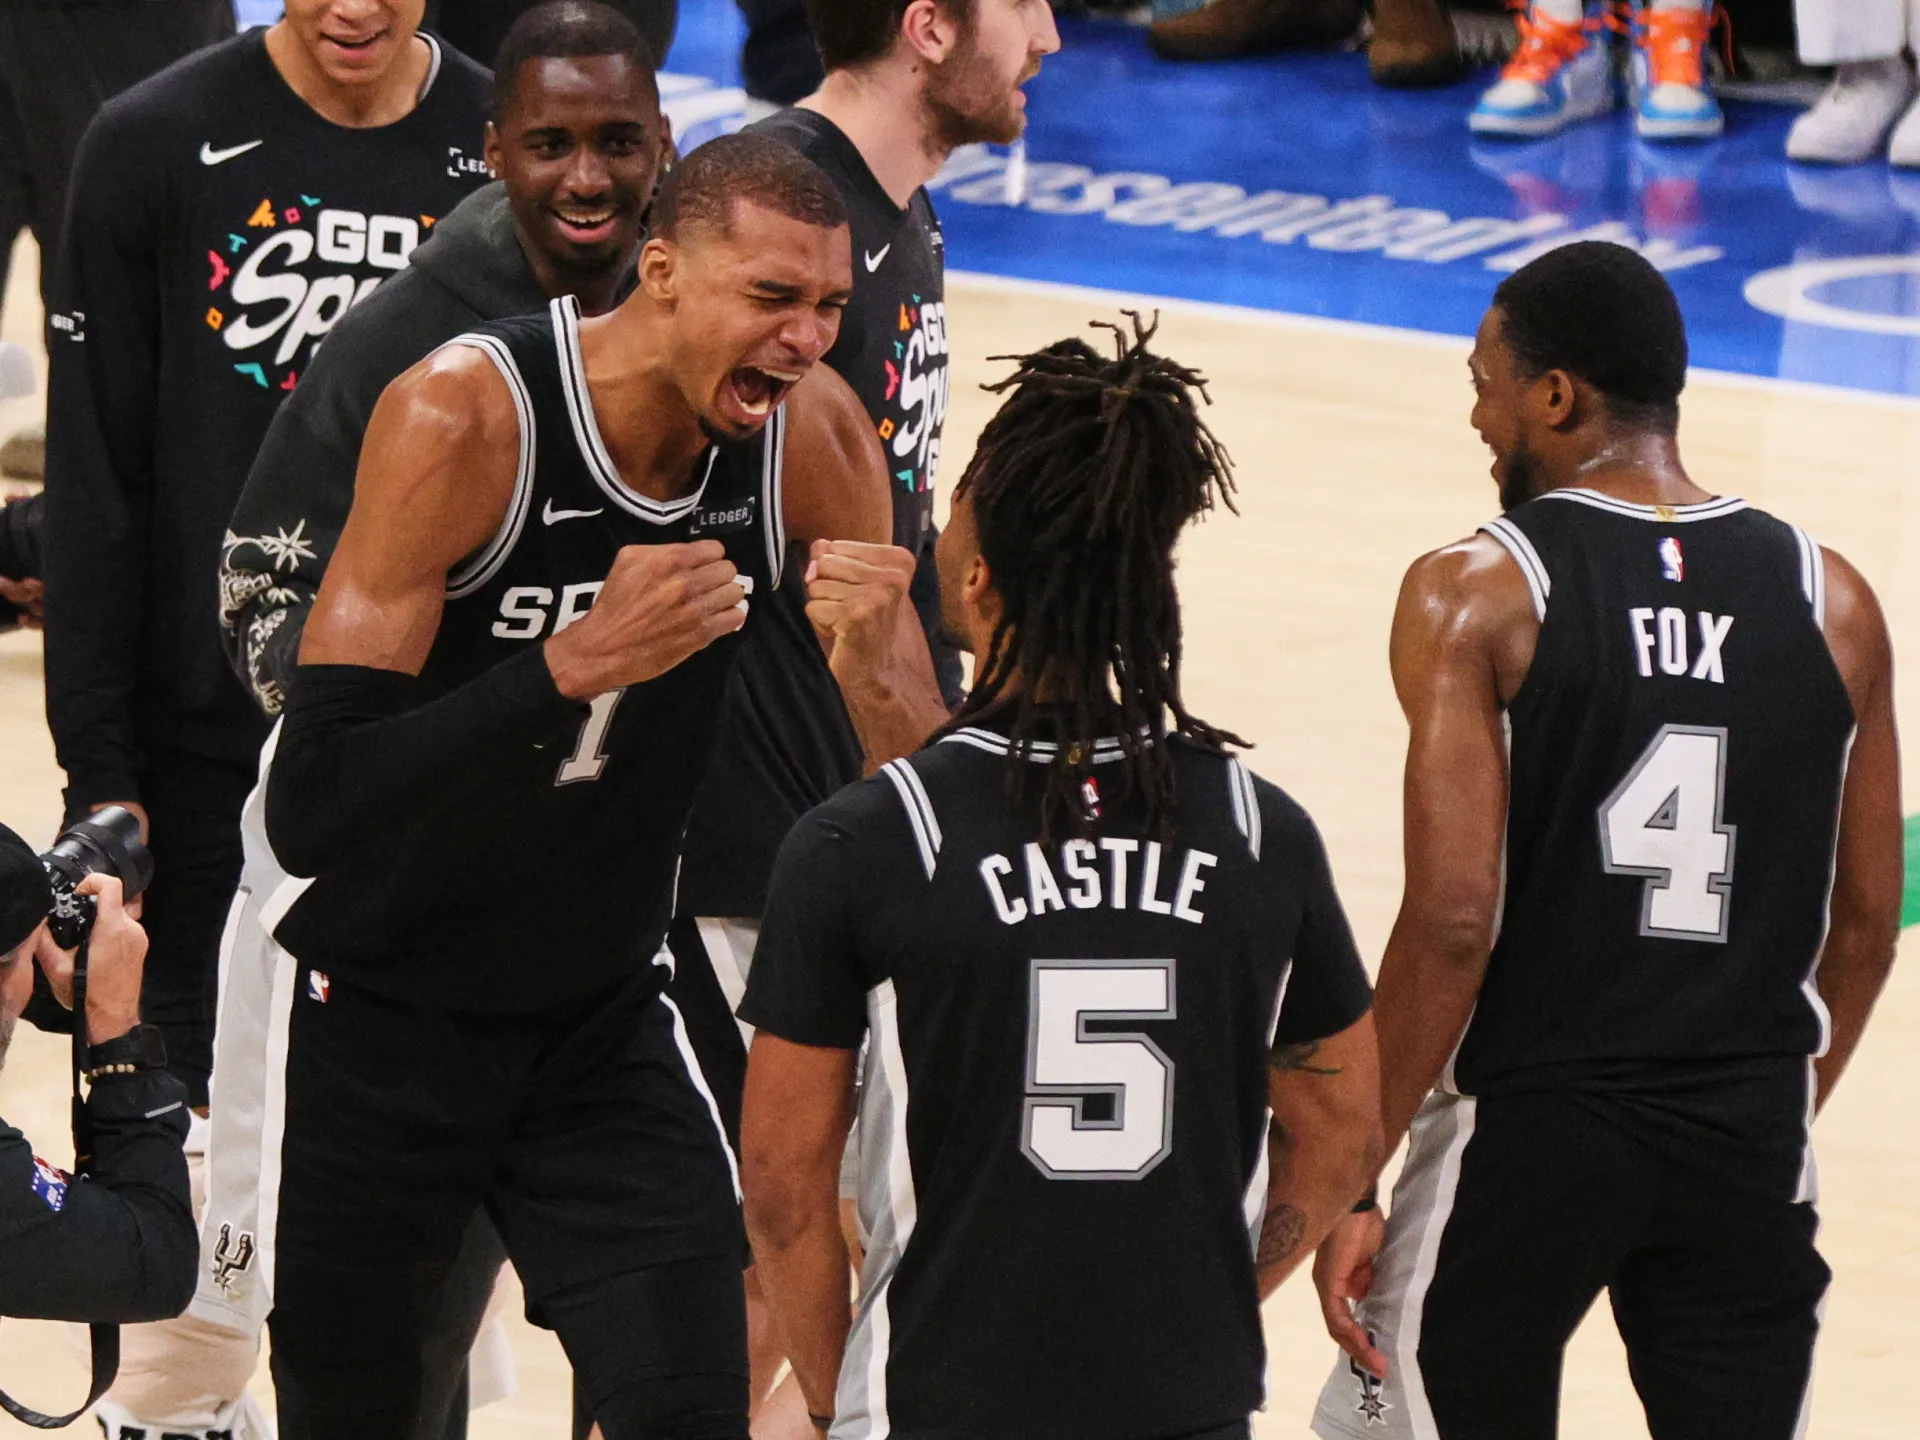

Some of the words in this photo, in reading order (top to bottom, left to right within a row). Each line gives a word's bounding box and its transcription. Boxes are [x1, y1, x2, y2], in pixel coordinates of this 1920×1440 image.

[317, 209, 419, 270] GO
[700, 506, 748, 526] LEDGER
[1628, 606, 1734, 684] FOX
[554, 686, 627, 788] 1
[1598, 723, 1737, 944] 4
[979, 836, 1218, 925] CASTLE
[1020, 958, 1176, 1180] 5
